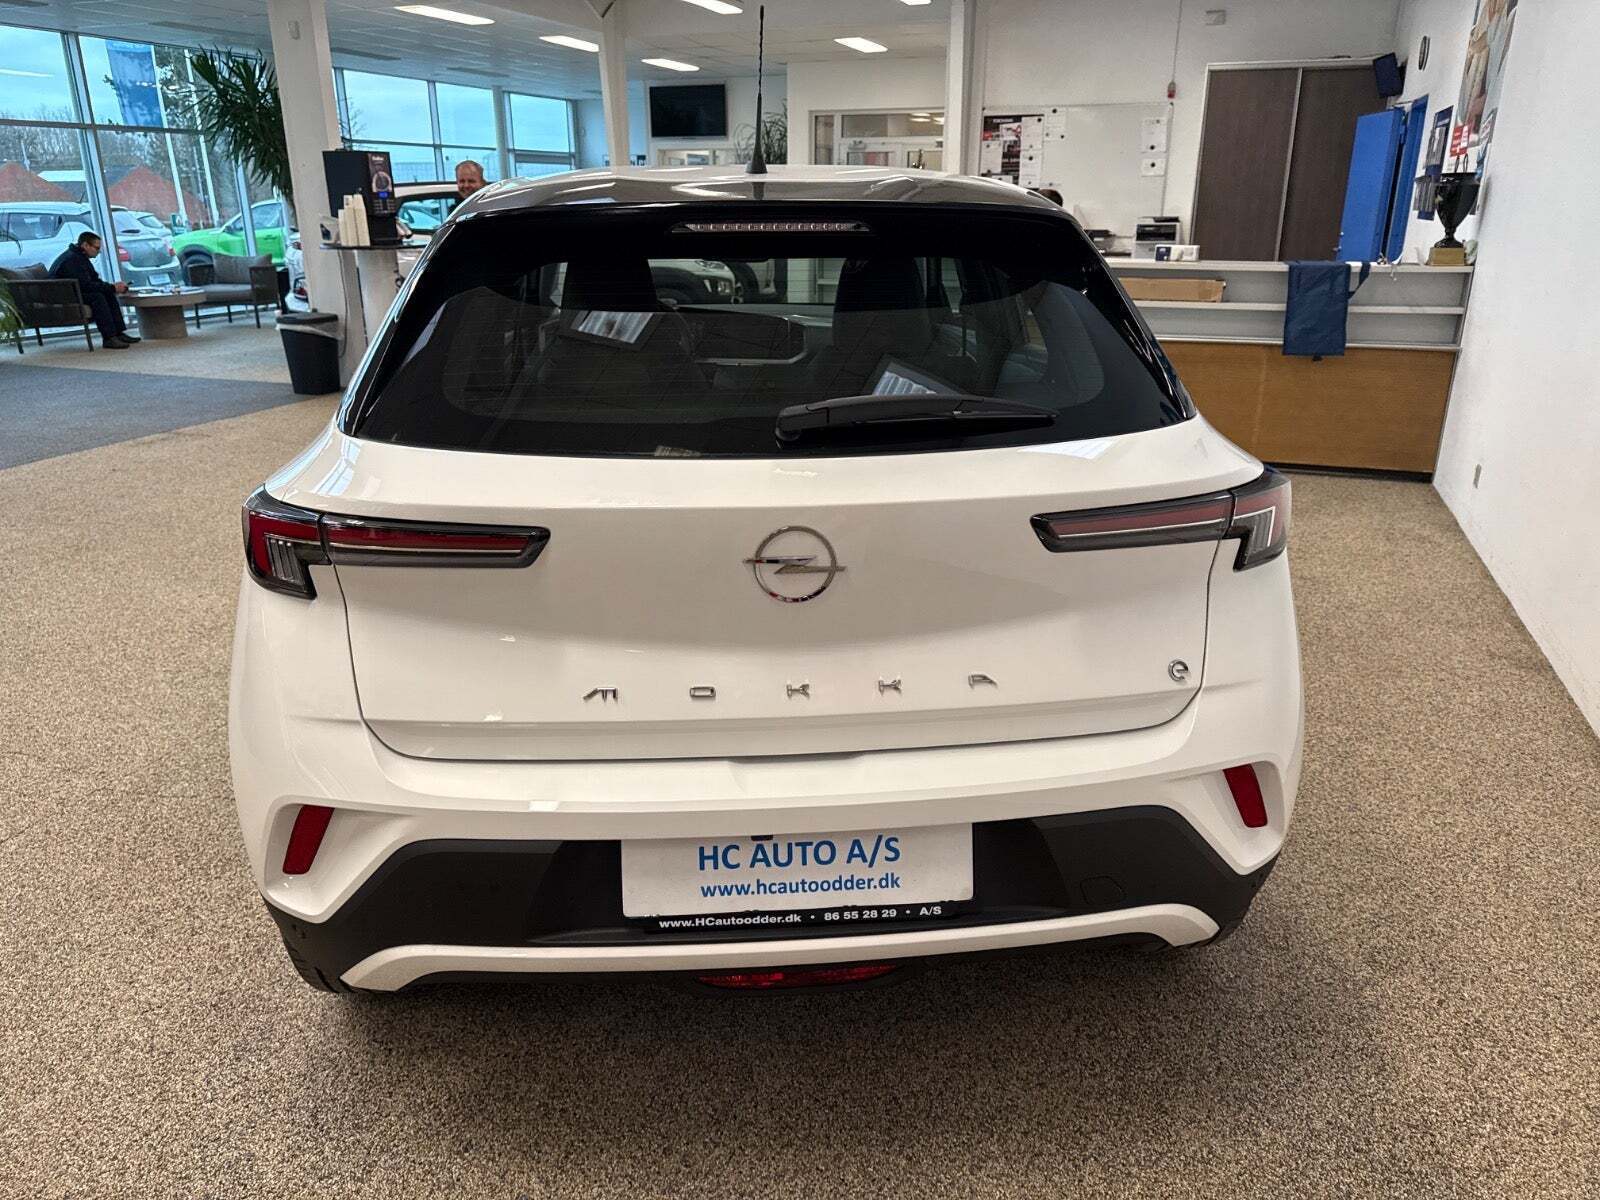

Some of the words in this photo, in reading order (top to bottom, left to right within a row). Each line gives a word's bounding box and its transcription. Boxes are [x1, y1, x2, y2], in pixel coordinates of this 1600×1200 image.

[583, 672, 998, 704] MOKKA
[698, 843, 740, 871] HC
[750, 840, 837, 869] AUTO
[846, 834, 901, 868] A/S
[700, 872, 901, 897] www.hcautoodder.dk
[659, 912, 802, 929] www.HCautoodder.dk
[824, 909, 842, 921] 86
[843, 909, 860, 920] 55
[862, 908, 878, 920] 28
[880, 908, 897, 919] 29
[919, 905, 942, 916] A/S
